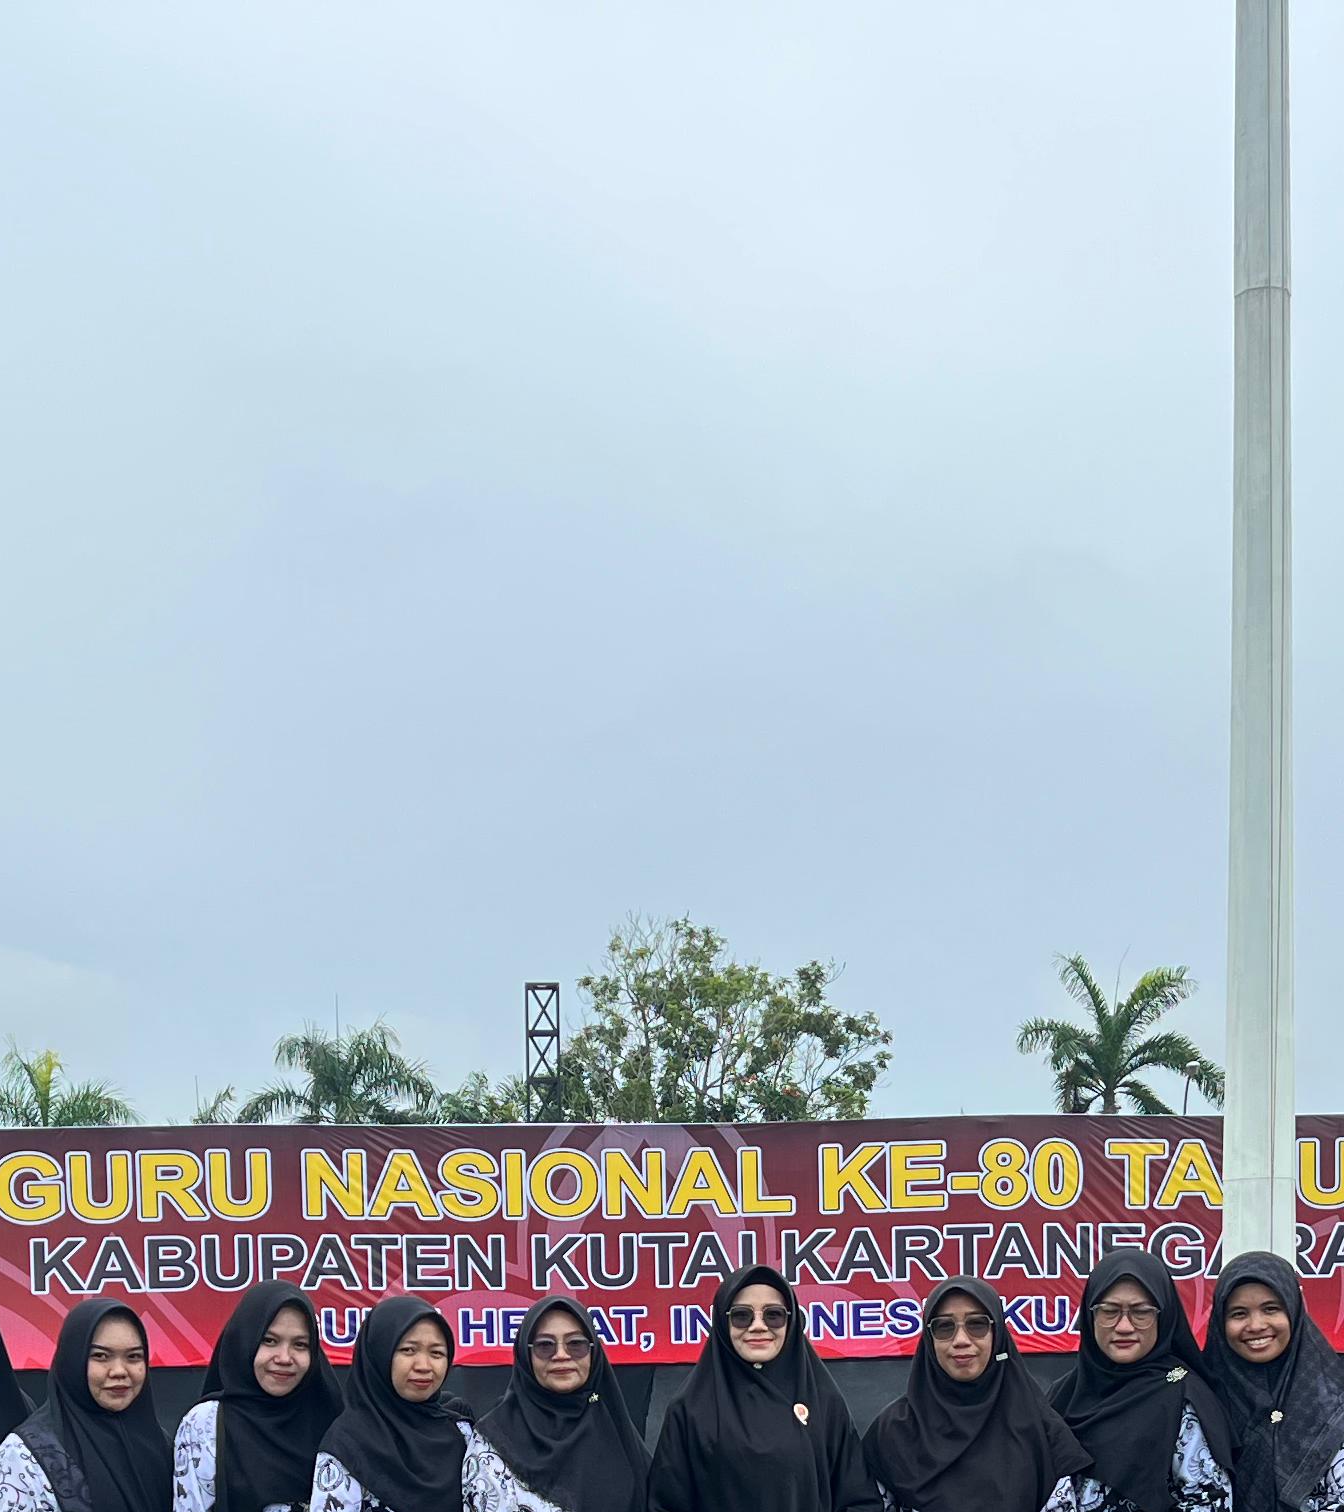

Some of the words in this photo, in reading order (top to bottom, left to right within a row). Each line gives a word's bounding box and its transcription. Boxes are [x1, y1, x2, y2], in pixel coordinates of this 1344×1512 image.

[301, 1146, 795, 1223] NASIONAL
[818, 1138, 1083, 1215] KE-80
[30, 1232, 506, 1294] KABUPATEN
[459, 1305, 654, 1352] HEAT,
